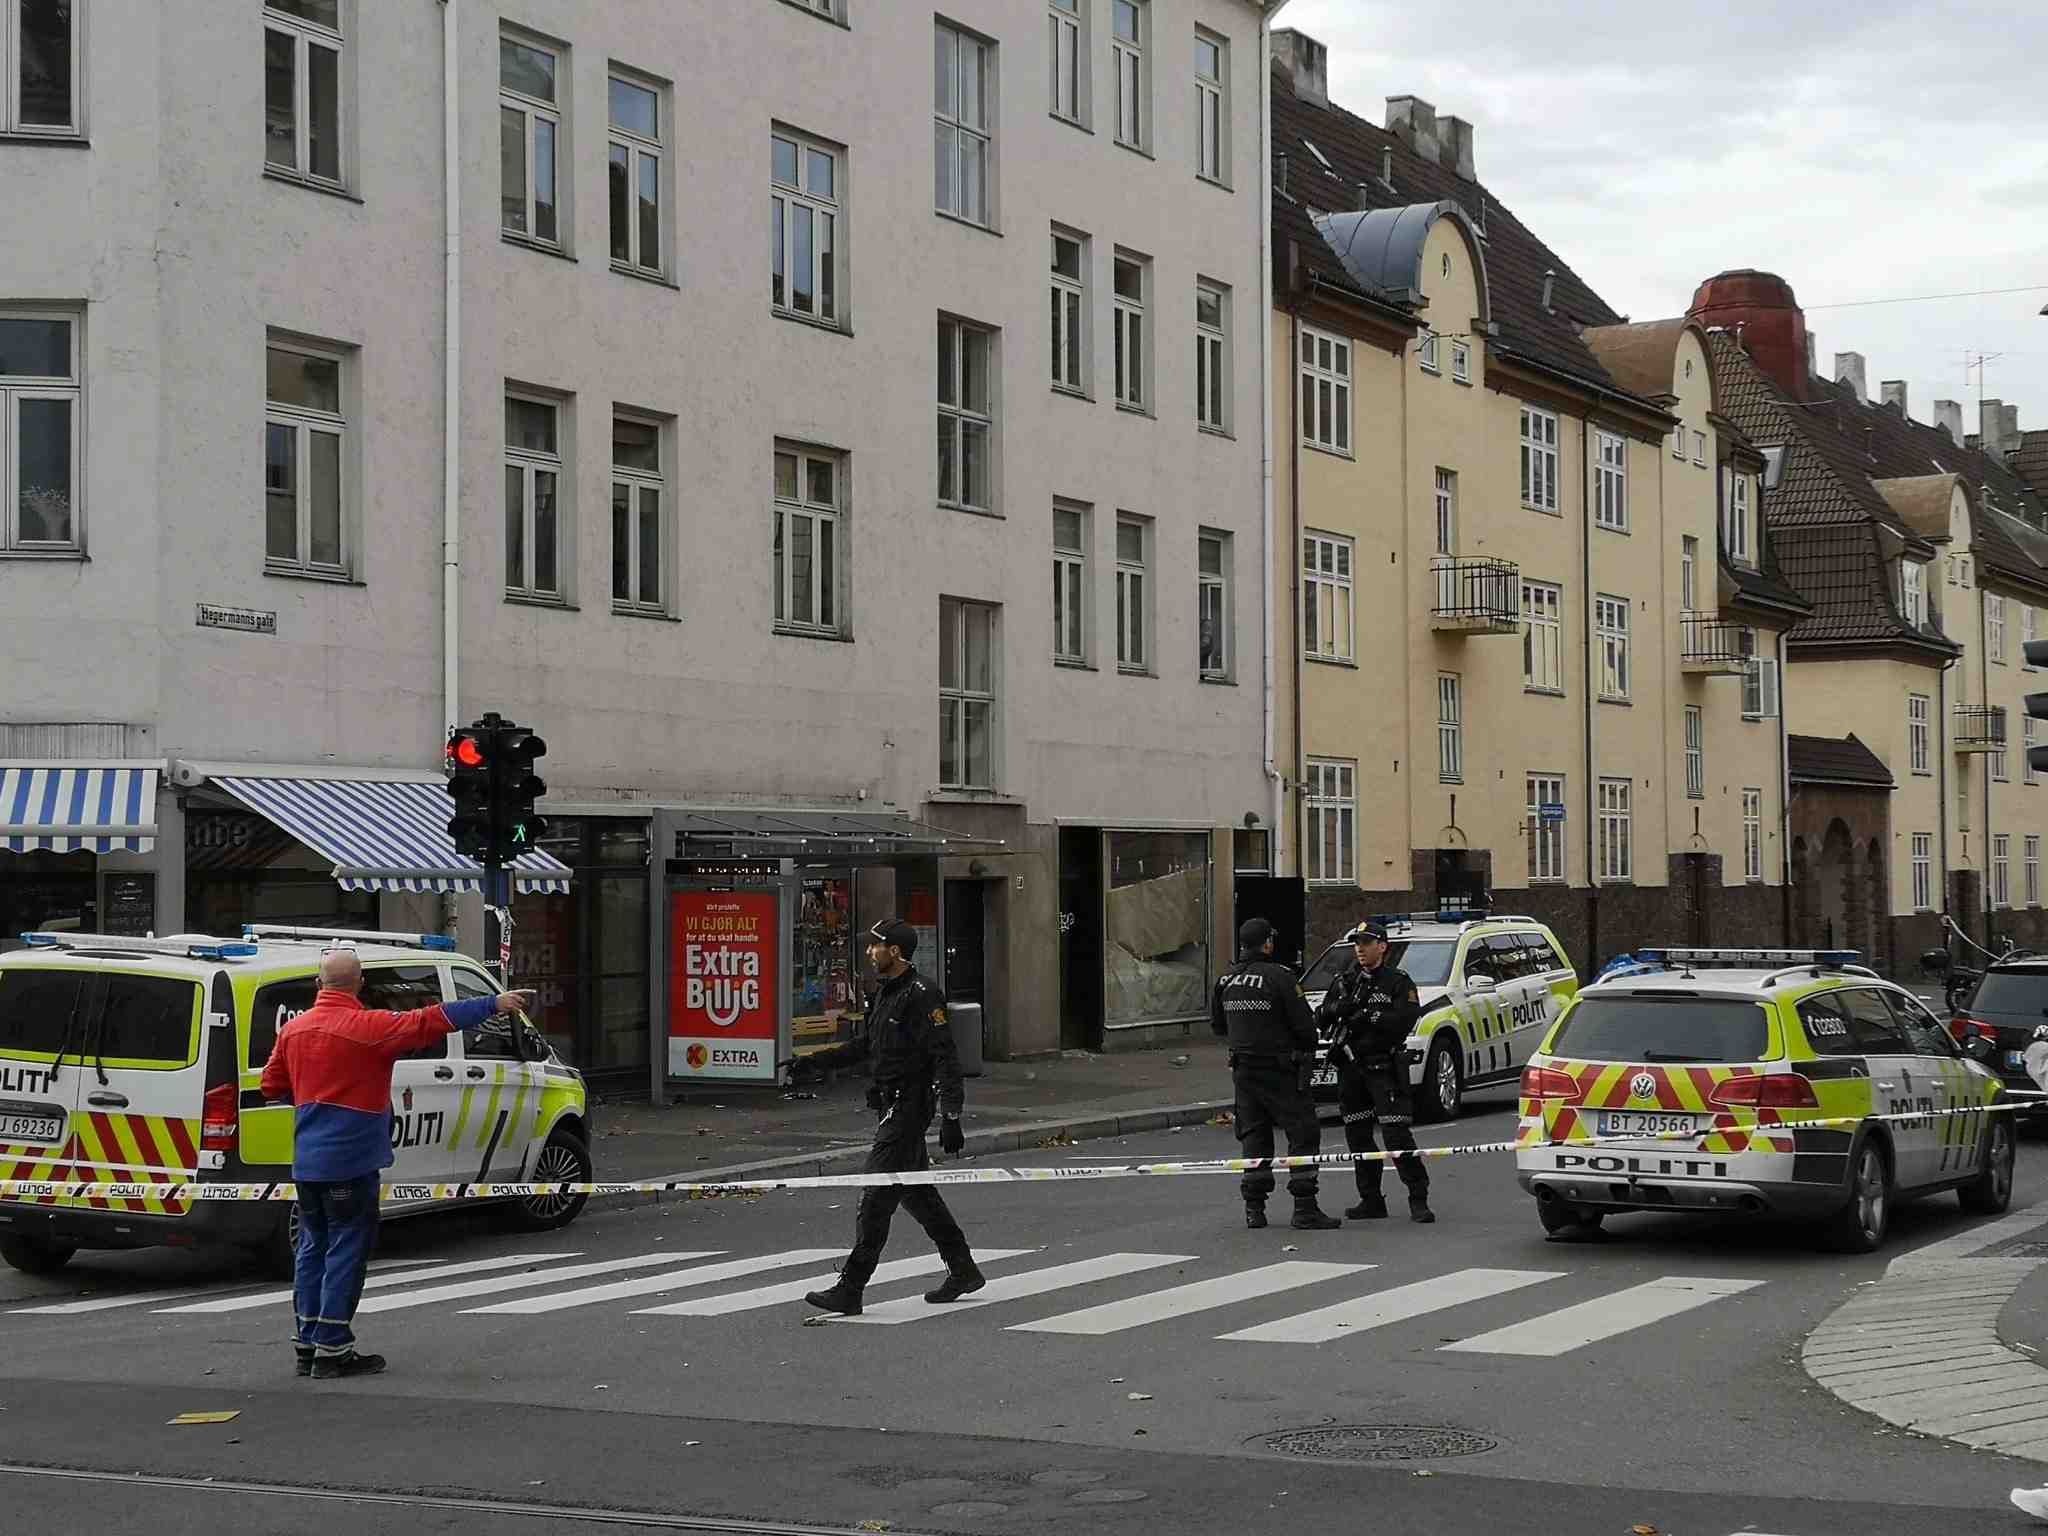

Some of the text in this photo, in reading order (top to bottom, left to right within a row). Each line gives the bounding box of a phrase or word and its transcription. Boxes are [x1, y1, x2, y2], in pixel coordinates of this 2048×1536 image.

[687, 917, 759, 930] VI GJØR ALT
[686, 933, 759, 942] for at du skal handle
[686, 944, 760, 976] Extra
[1219, 974, 1263, 989] POLITI
[1512, 999, 1547, 1028] POLITI
[711, 1050, 759, 1064] EXTRA
[0, 1067, 50, 1094] LITI
[1890, 1096, 1934, 1131] POLITI
[12, 1118, 55, 1136] 69236
[390, 1111, 444, 1149] OLITI
[1611, 1114, 1689, 1132] BT 20566
[1556, 1154, 1727, 1178] POLITI
[18, 1183, 52, 1195] POLITI
[110, 1184, 145, 1197] POLITI
[203, 1187, 240, 1199] POLITI
[393, 1187, 431, 1199] POLITI
